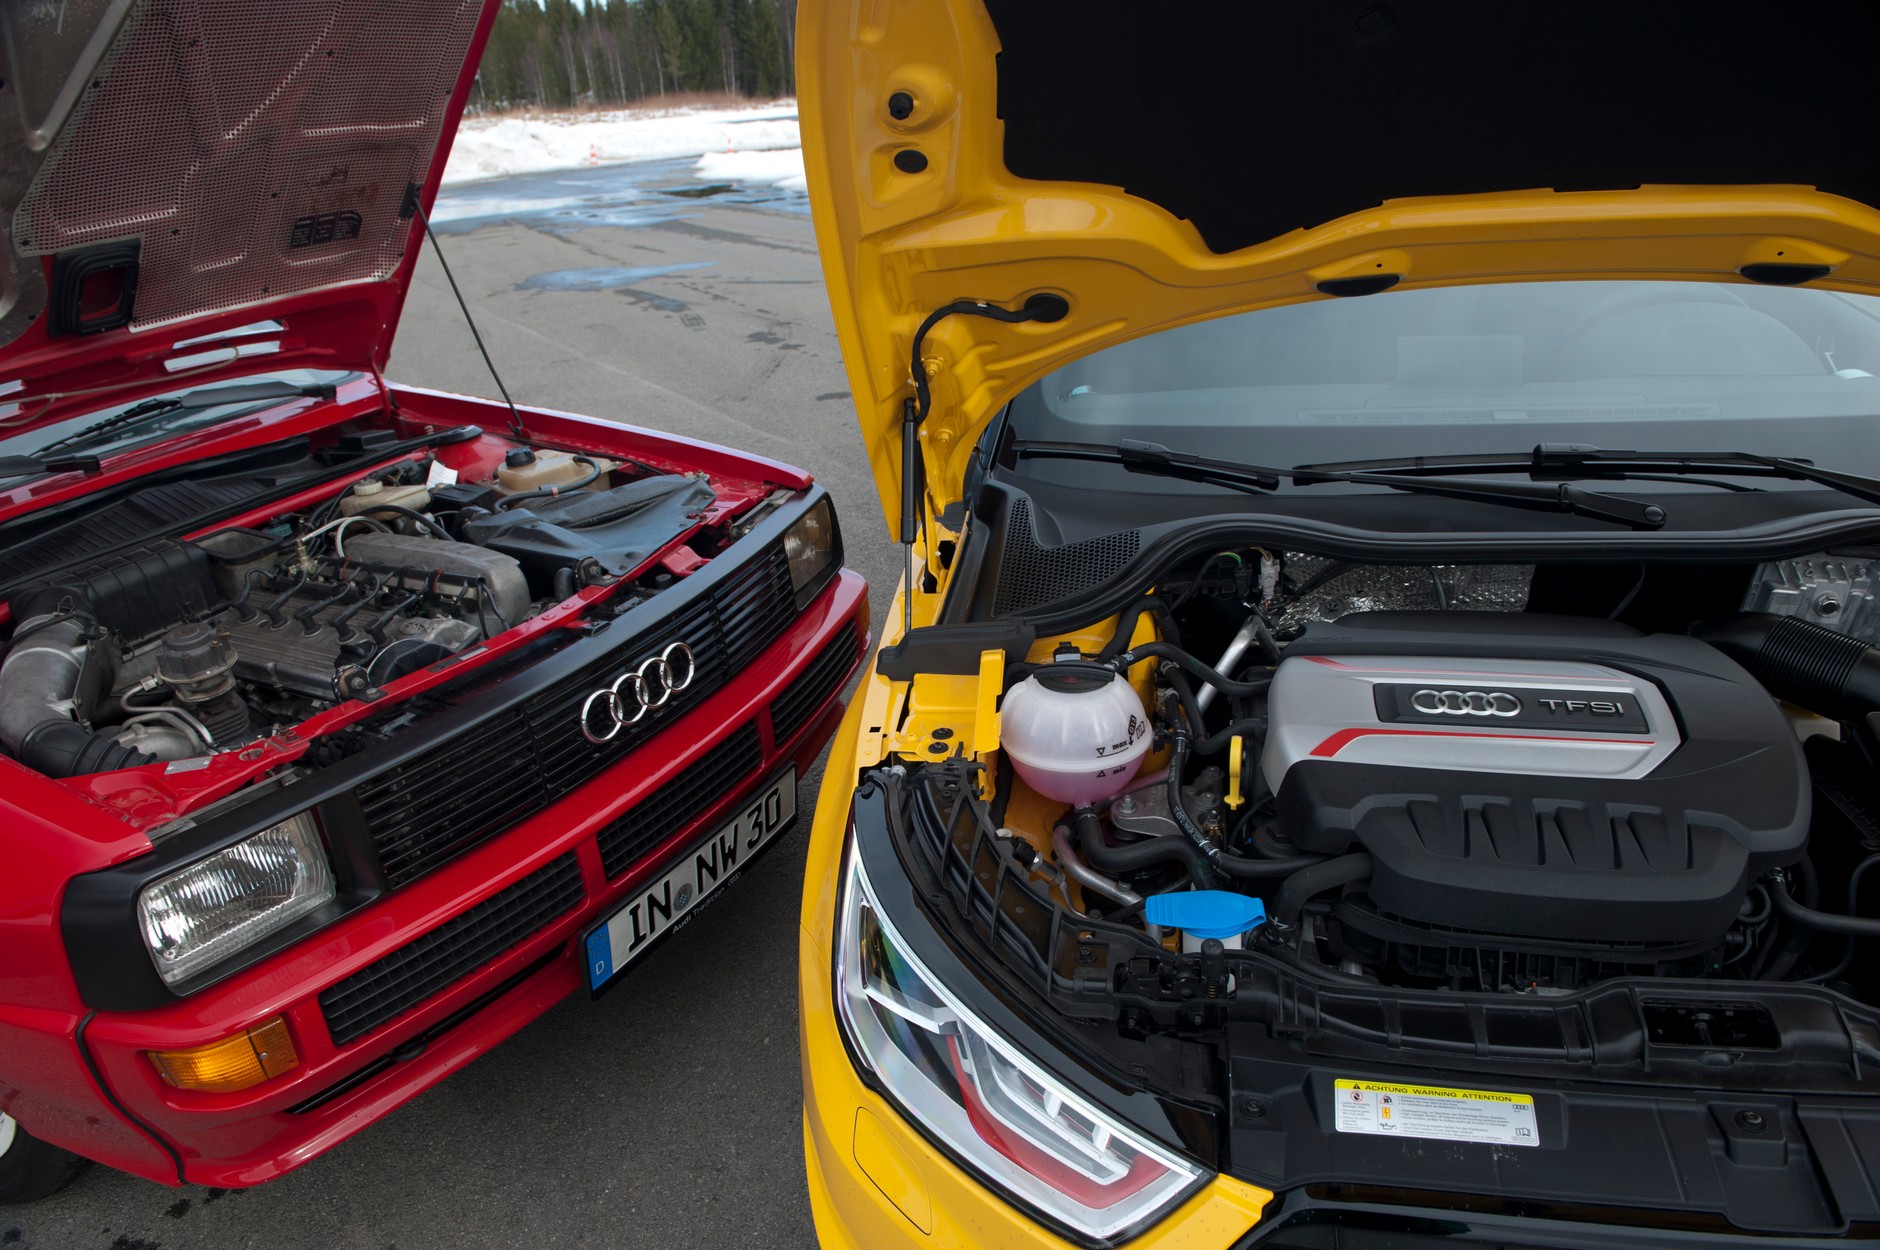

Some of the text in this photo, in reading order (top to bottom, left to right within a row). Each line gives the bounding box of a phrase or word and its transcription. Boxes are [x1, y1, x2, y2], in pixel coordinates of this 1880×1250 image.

[1539, 699, 1625, 715] TFSI
[1112, 740, 1127, 750] max
[1112, 766, 1127, 775] min
[627, 787, 782, 953] IN NW 30
[672, 887, 725, 934] Audi Tradition
[595, 960, 605, 976] D
[1364, 1085, 1512, 1102] ACHTUNG WARNING ATTENTION
